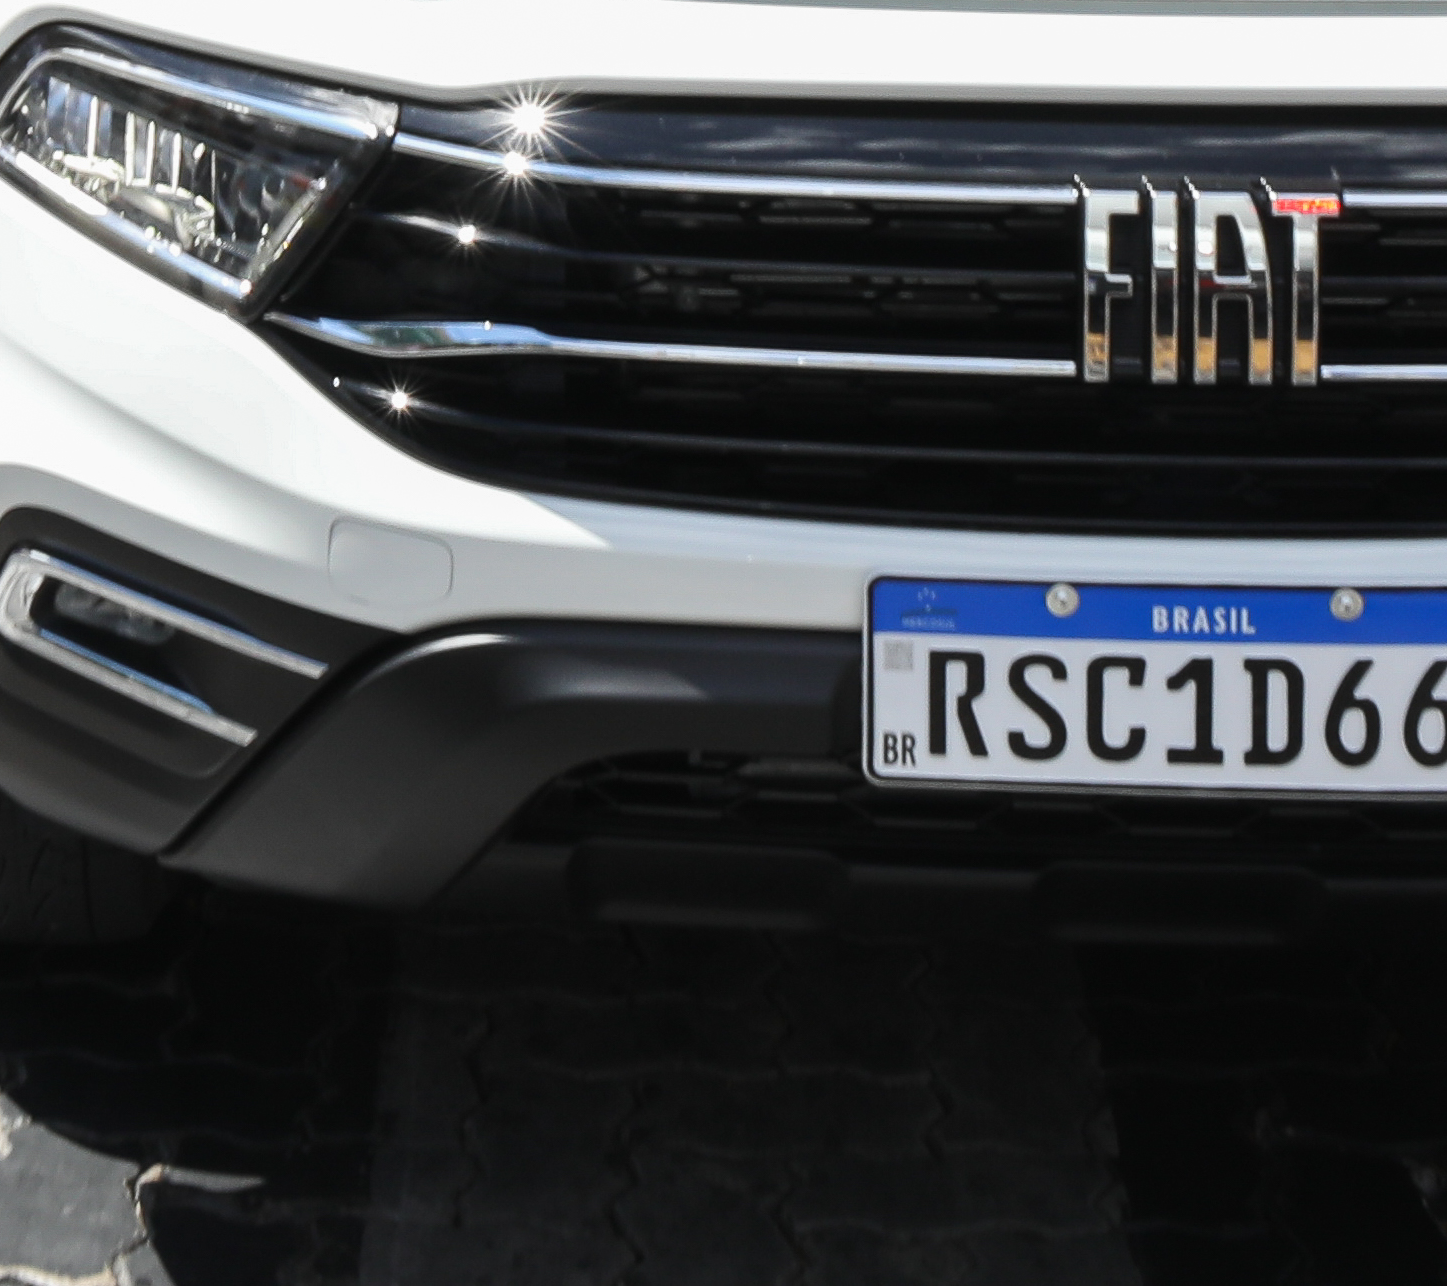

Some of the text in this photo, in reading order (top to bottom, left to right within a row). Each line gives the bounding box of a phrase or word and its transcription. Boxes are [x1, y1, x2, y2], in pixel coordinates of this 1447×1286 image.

[1082, 189, 1342, 384] FIAT
[1151, 604, 1257, 636] BRASIL
[883, 732, 917, 767] BR
